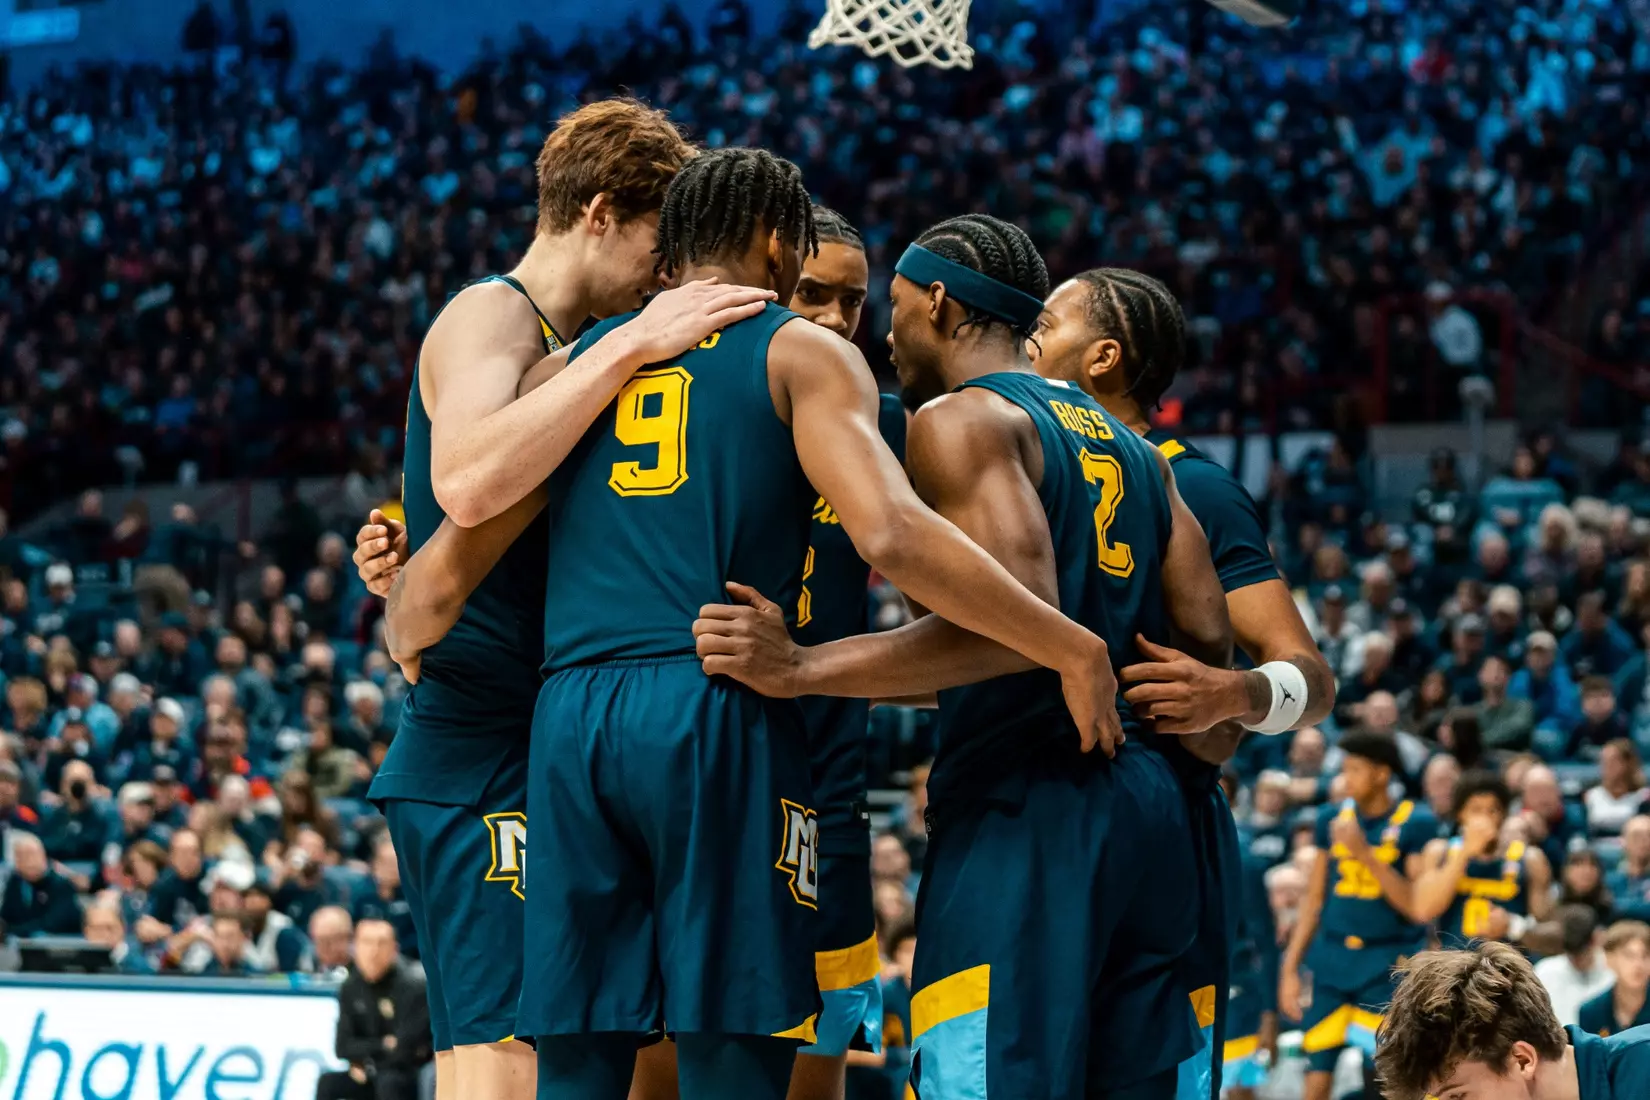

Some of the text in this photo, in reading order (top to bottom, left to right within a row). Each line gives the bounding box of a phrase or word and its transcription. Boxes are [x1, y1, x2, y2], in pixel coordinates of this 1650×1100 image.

[608, 366, 694, 497] 9
[1049, 400, 1115, 440] ROSS
[1078, 447, 1135, 578] 2
